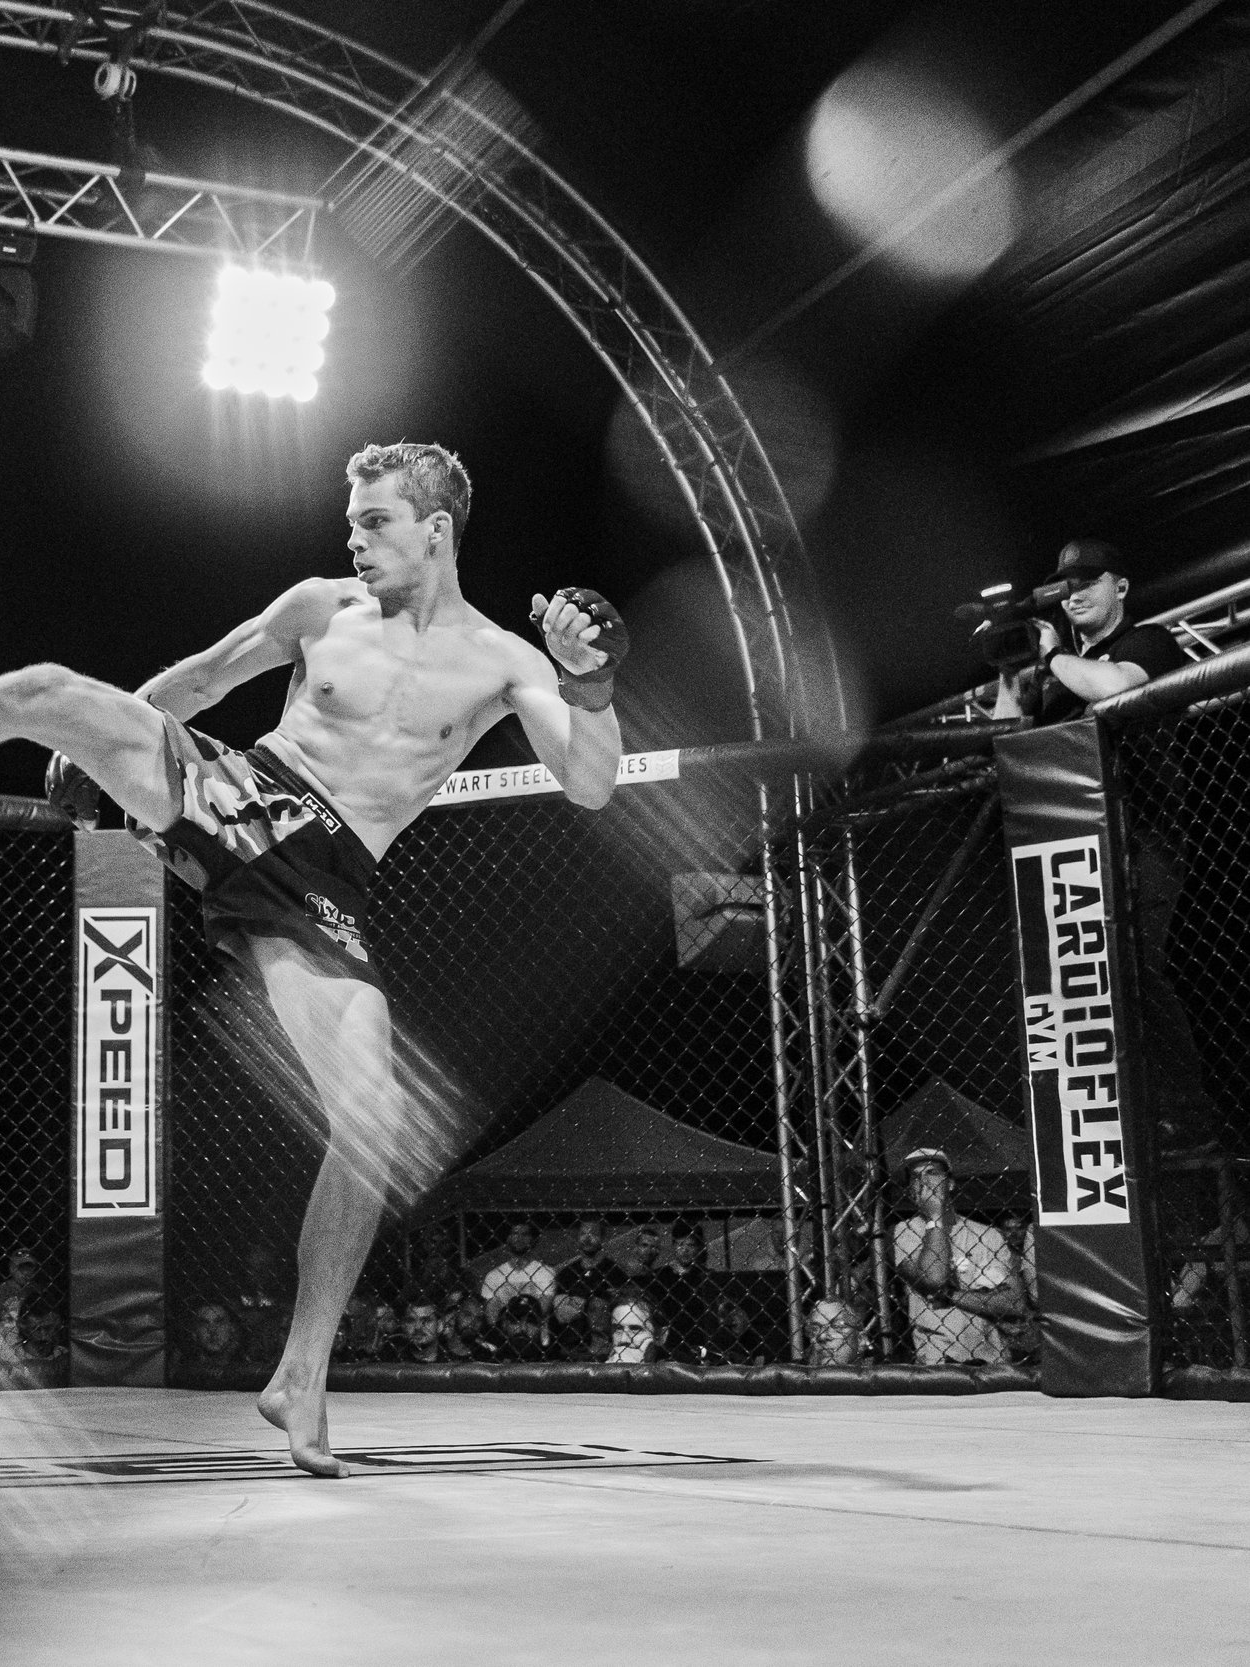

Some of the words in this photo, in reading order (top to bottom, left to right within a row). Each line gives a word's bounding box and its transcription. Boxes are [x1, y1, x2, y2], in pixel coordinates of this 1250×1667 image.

[435, 774, 492, 796] WART
[500, 768, 551, 787] STEEL
[83, 919, 154, 1190] XPEED
[1026, 996, 1058, 1068] GYM
[1050, 847, 1128, 1213] CARDIOFLEX
